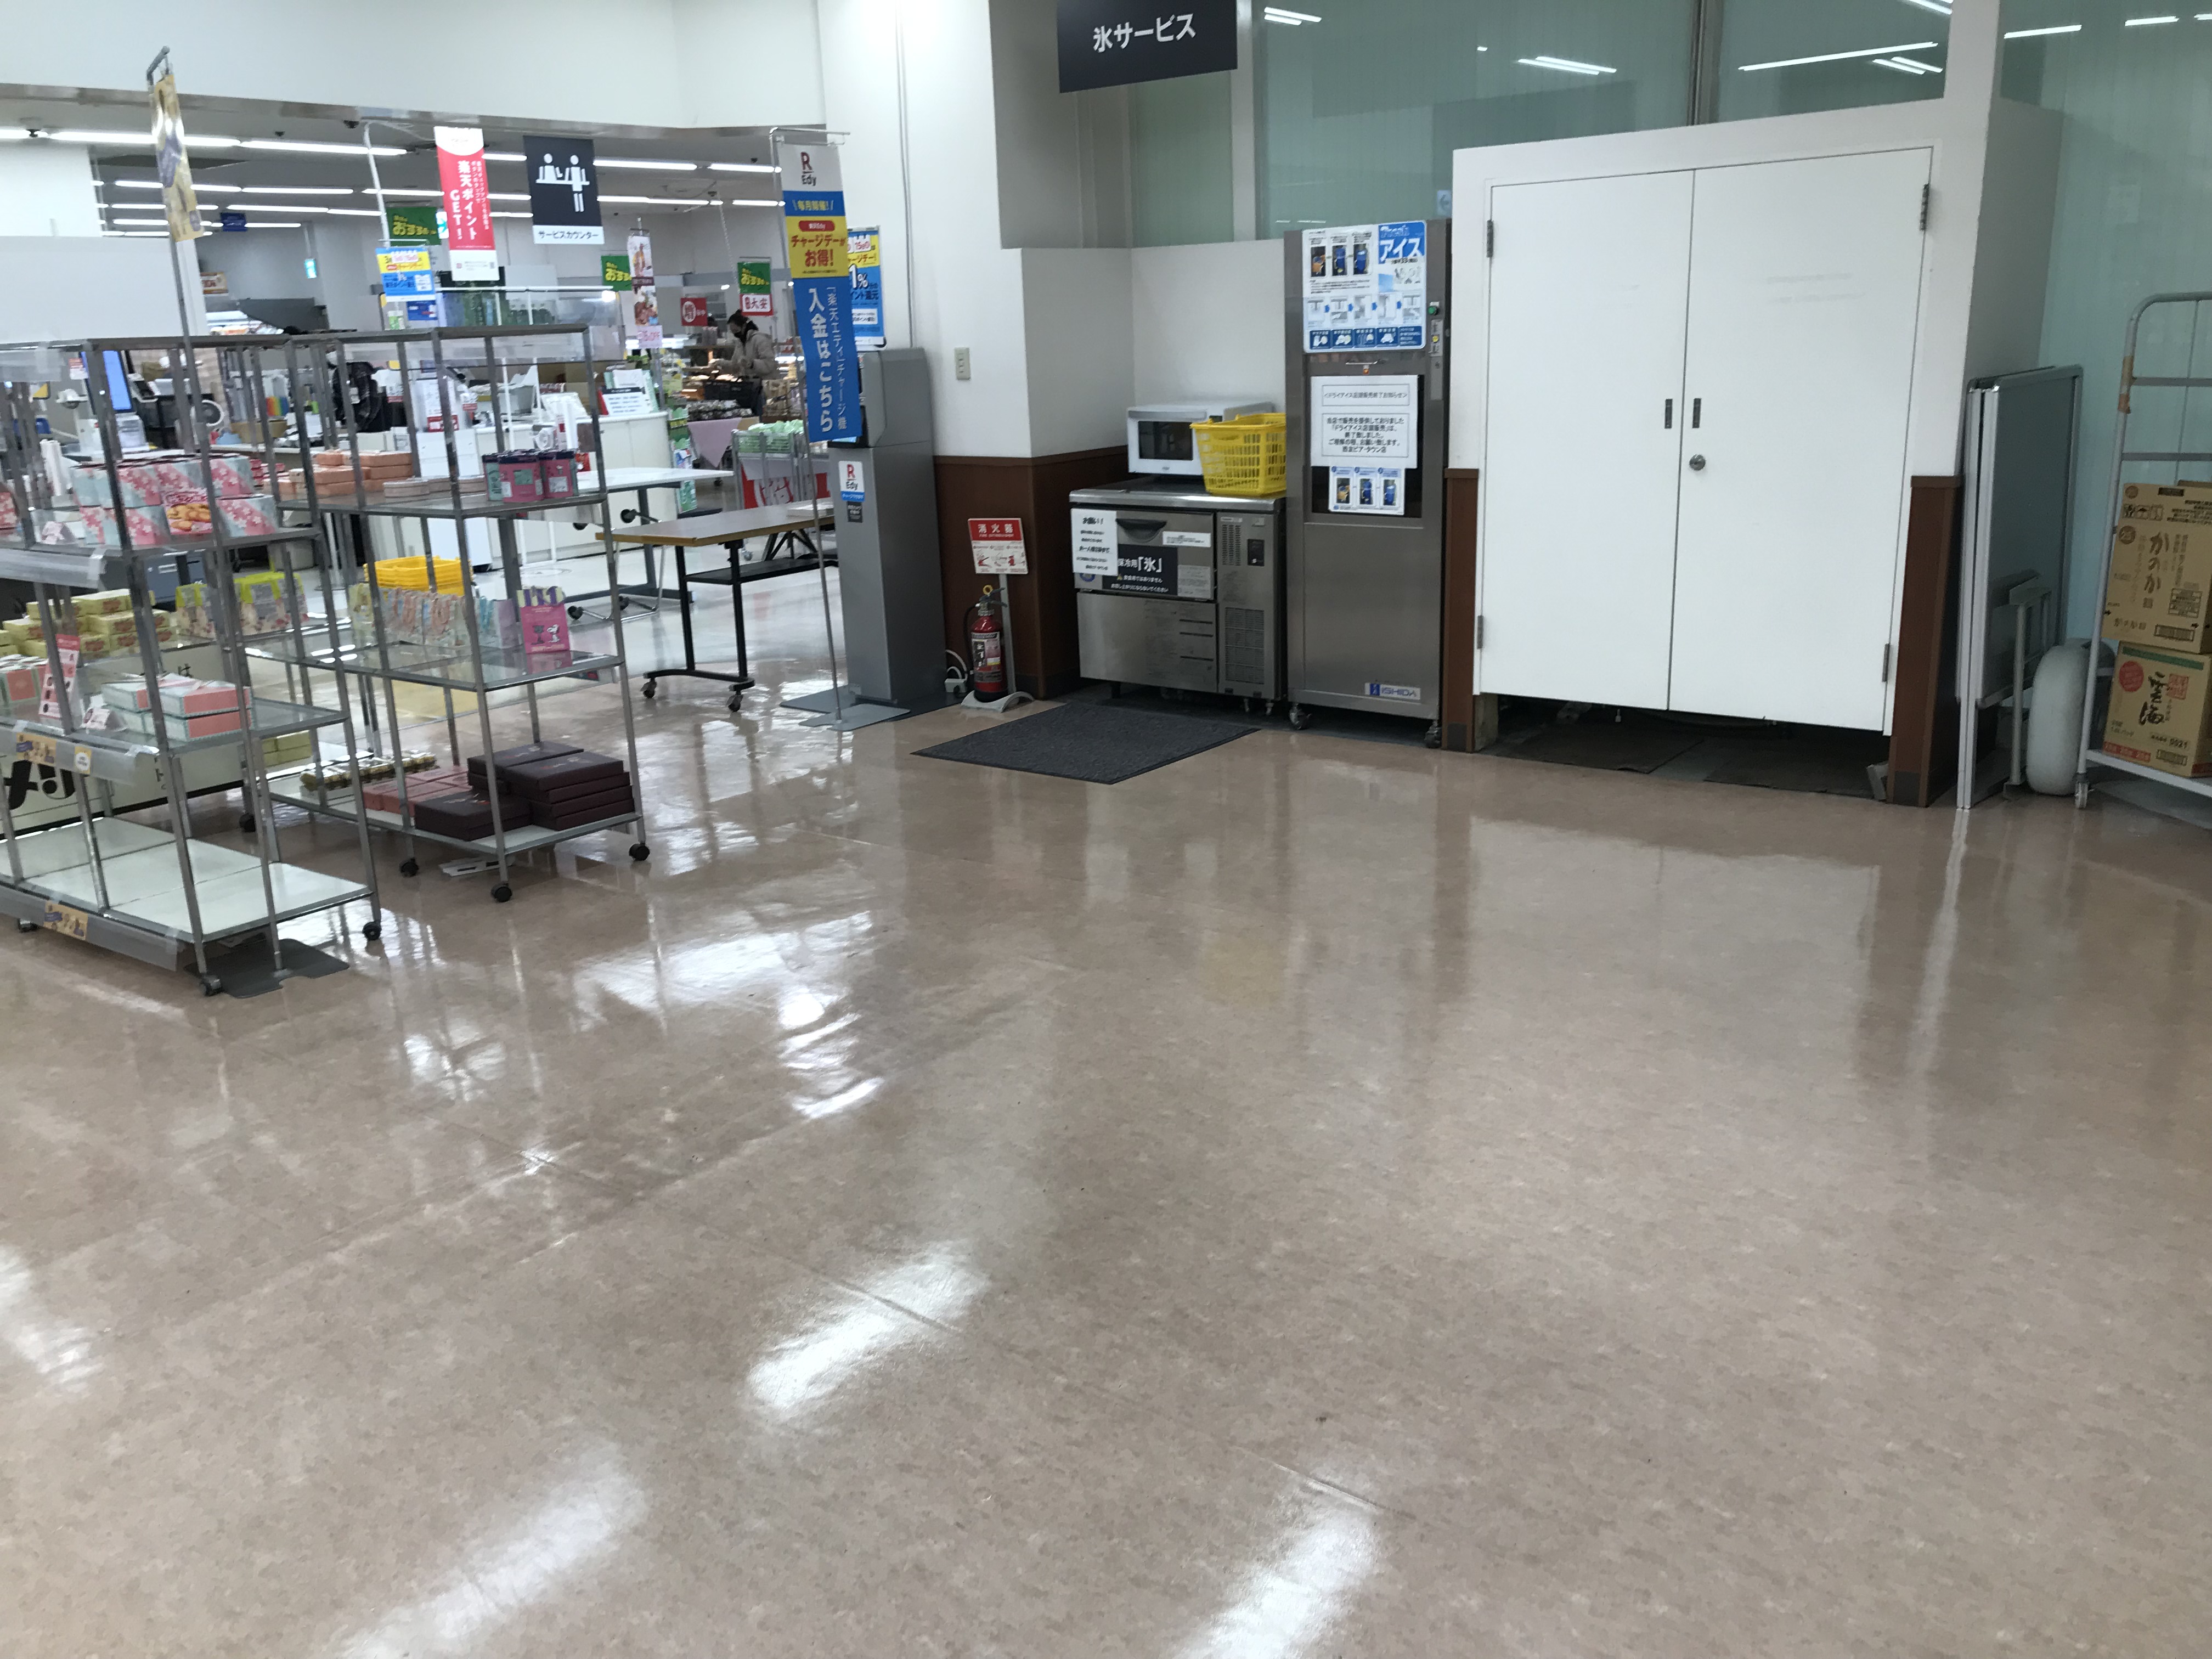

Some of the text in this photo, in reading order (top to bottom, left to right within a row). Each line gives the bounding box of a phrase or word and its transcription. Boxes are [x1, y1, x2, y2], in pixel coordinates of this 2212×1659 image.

[1093, 13, 1197, 53] 氷サービス
[800, 151, 812, 170] R
[801, 174, 817, 187] Edy
[458, 160, 477, 240] 楽天ポイント
[538, 230, 600, 240] サービスカウンター
[805, 249, 834, 268] お得!
[1380, 237, 1422, 262] アイス
[808, 287, 833, 432] 入金はこちら
[847, 464, 856, 478] R
[978, 523, 1014, 533] 消火器
